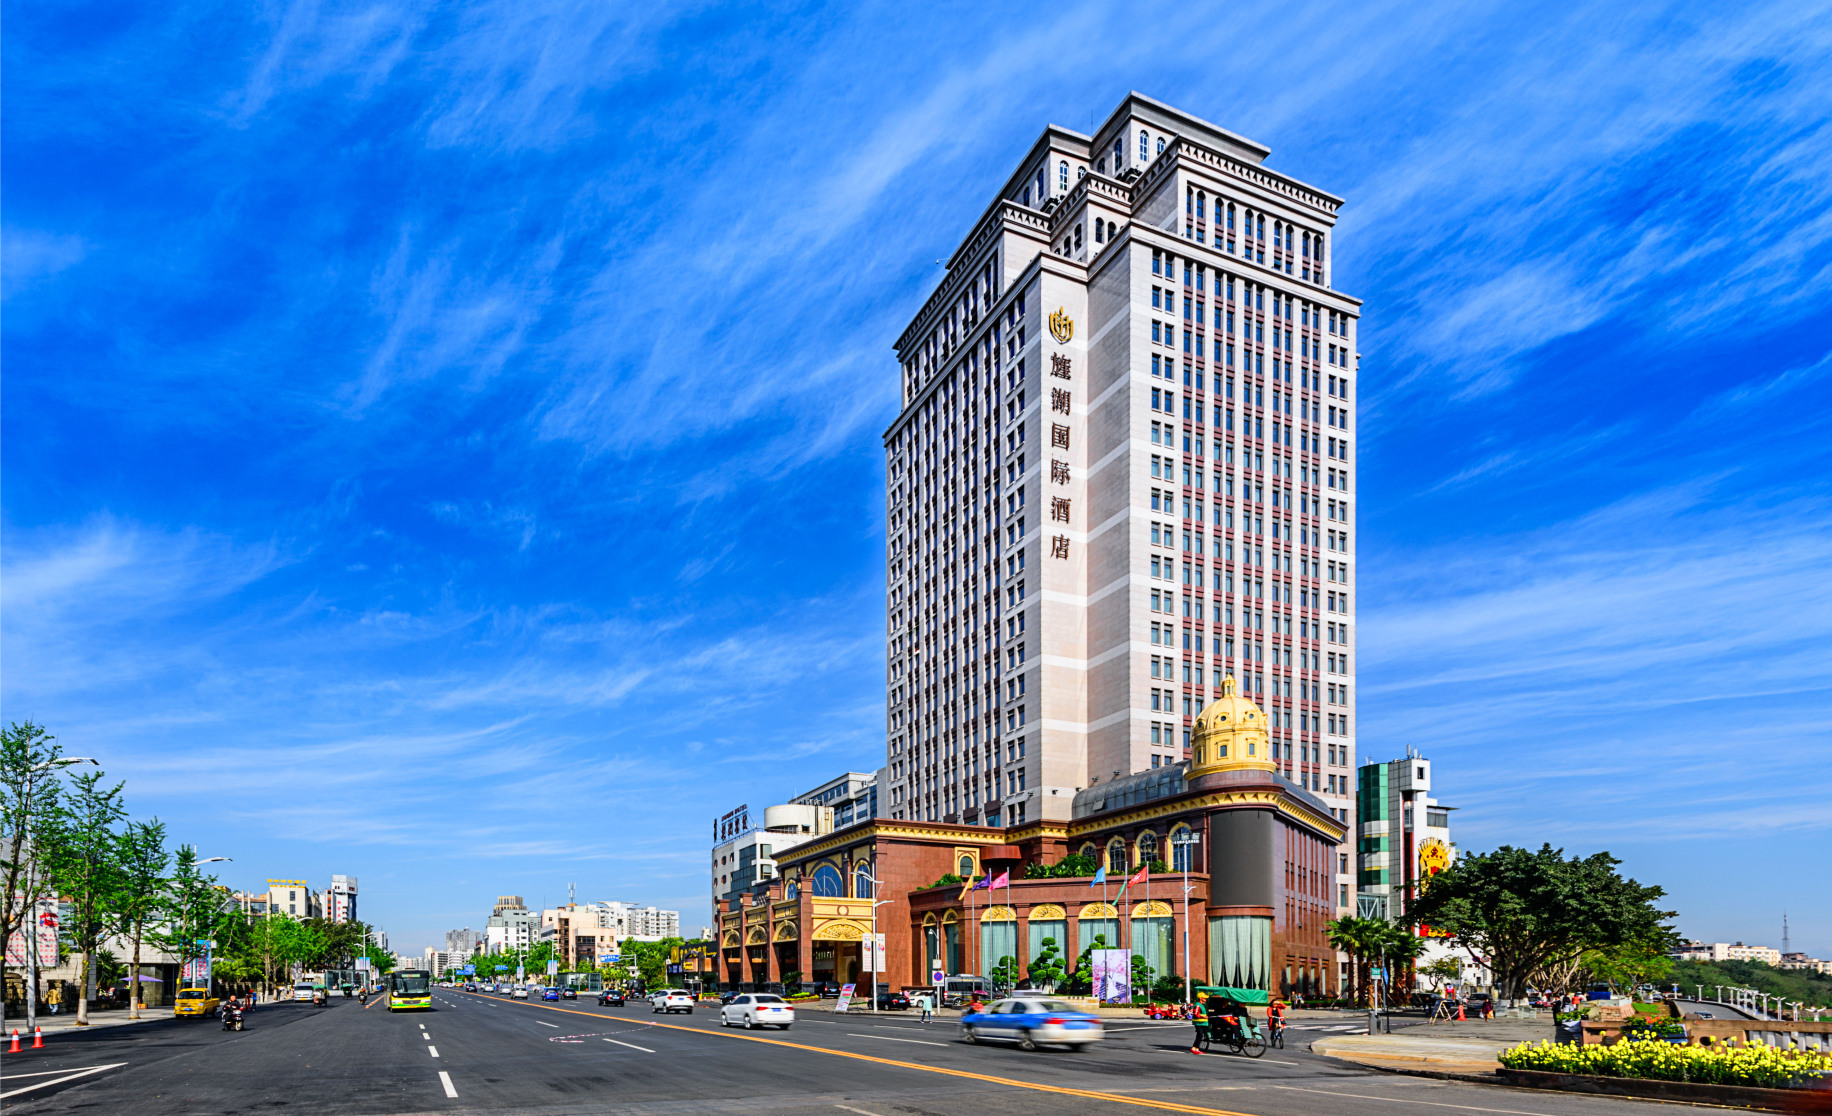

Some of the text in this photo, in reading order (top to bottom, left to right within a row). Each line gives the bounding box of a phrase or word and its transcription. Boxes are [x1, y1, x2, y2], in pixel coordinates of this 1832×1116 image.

[1050, 352, 1071, 560] 旌湖国际酒店
